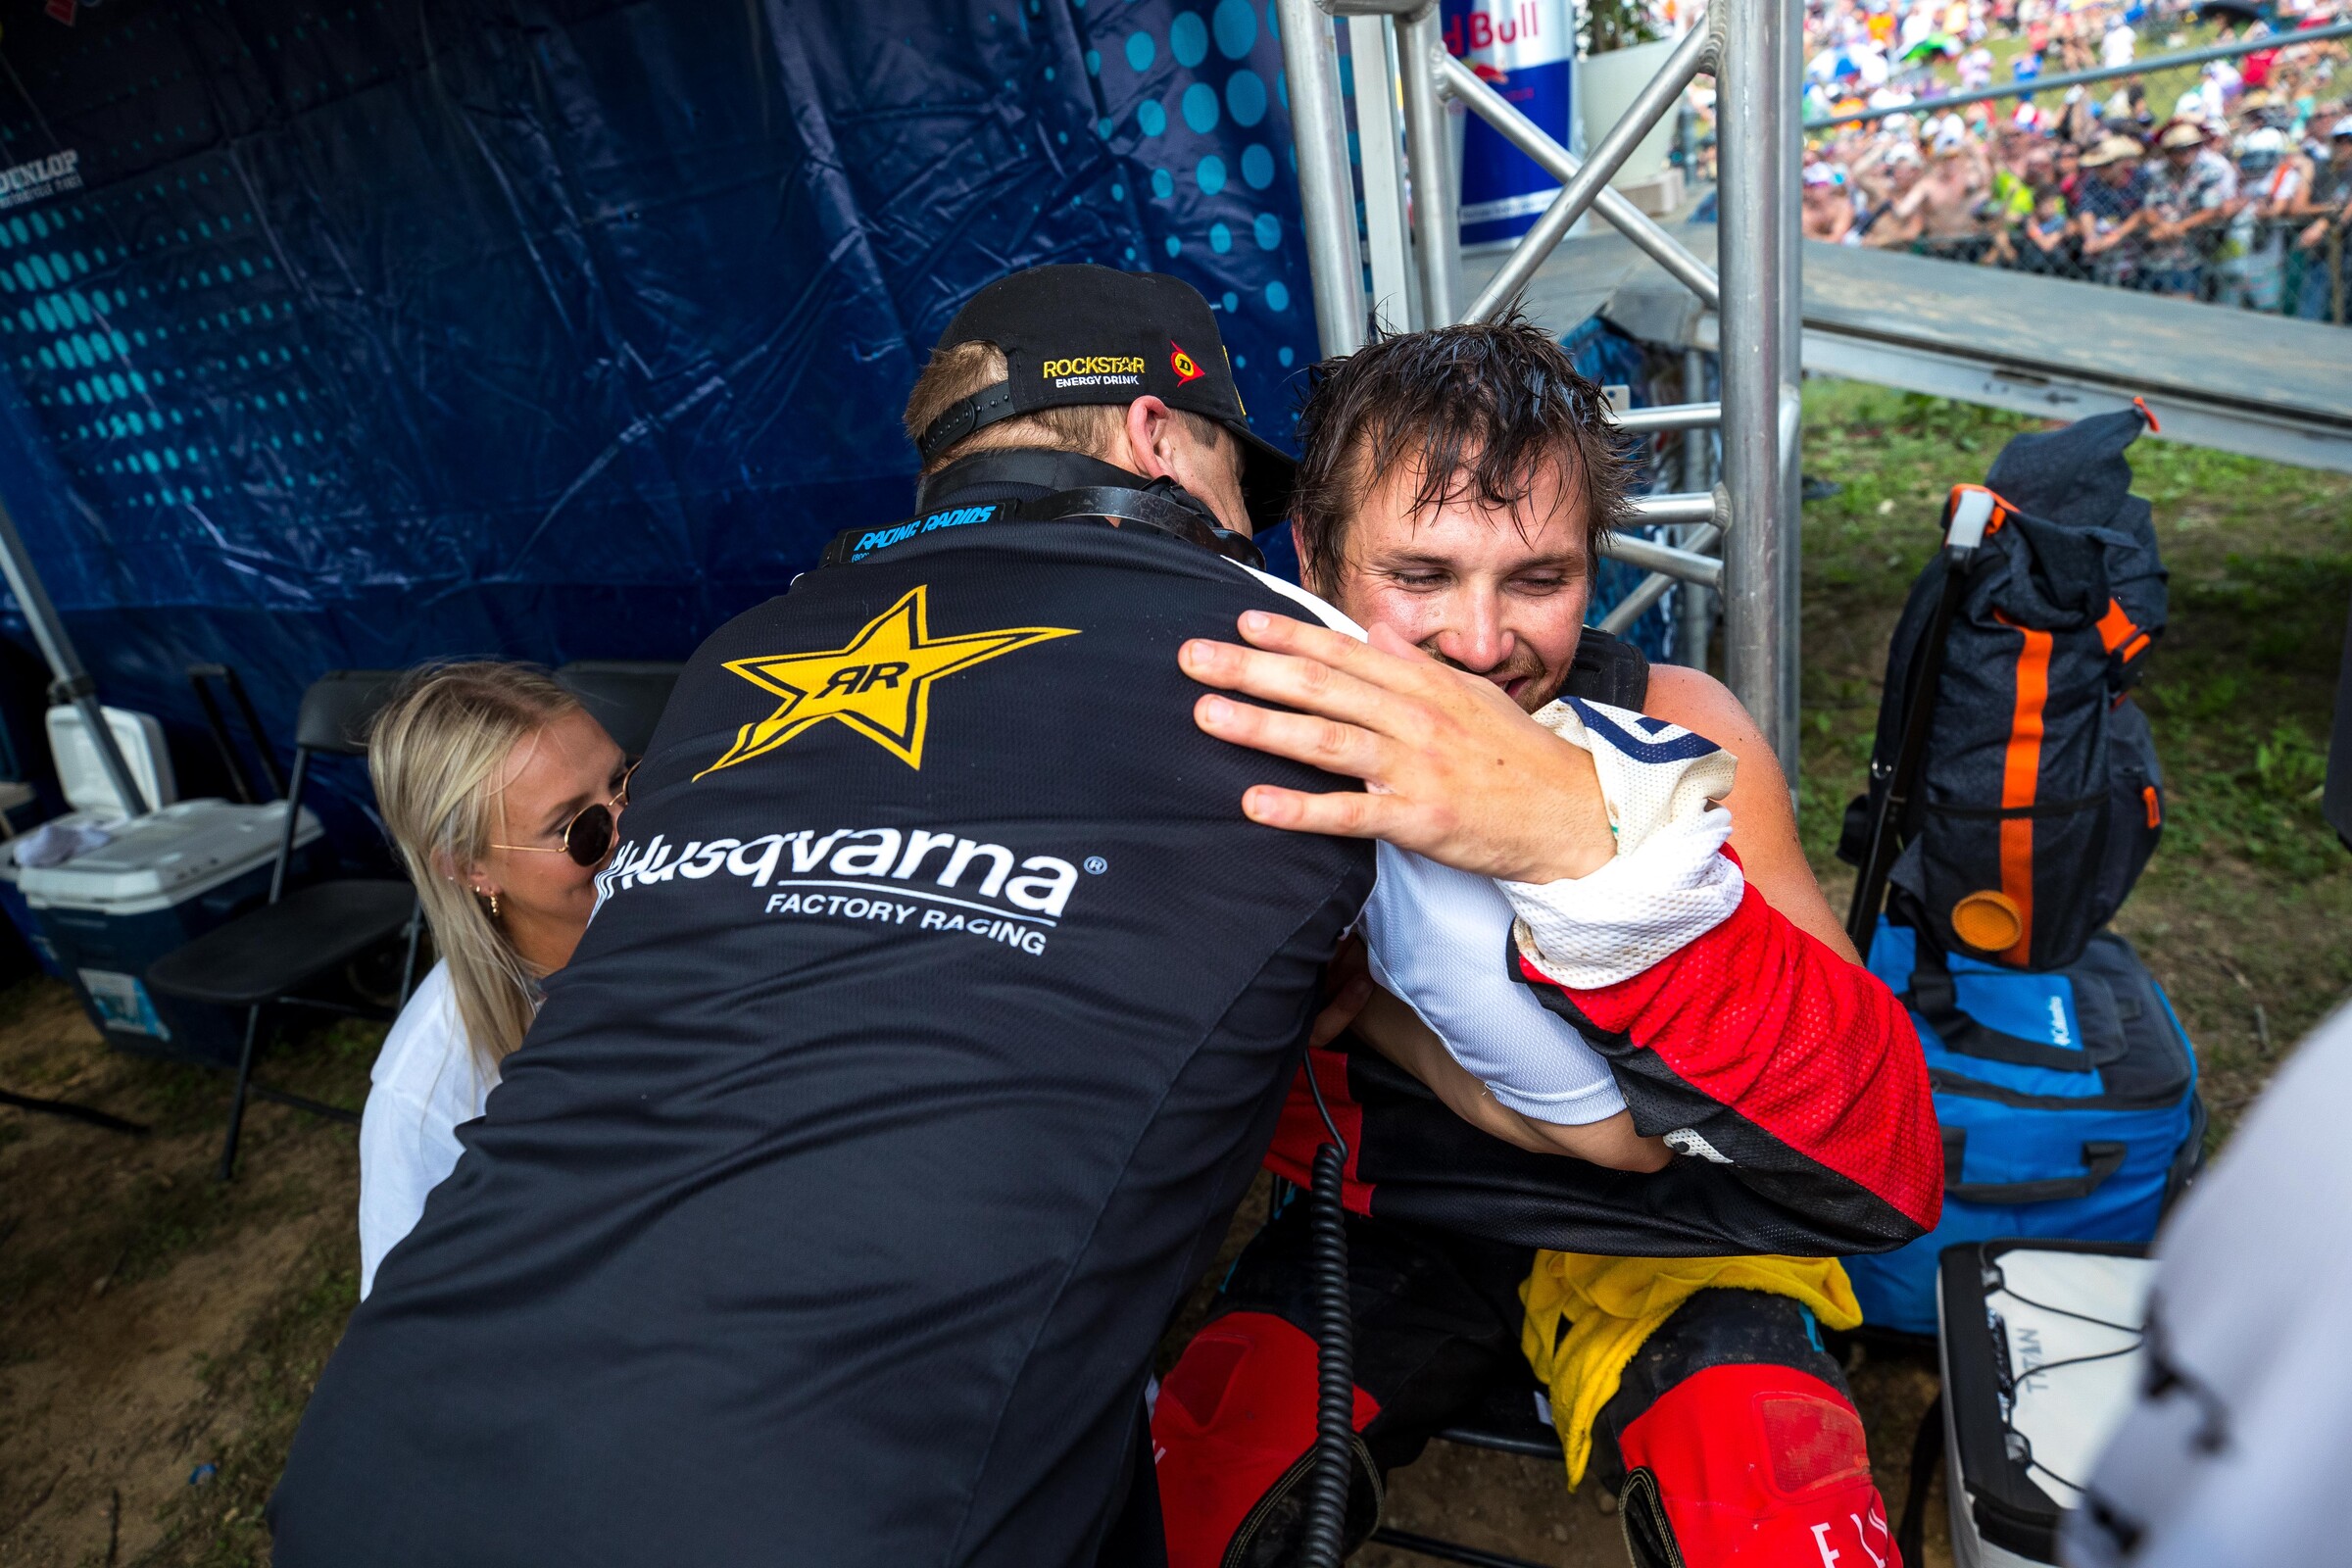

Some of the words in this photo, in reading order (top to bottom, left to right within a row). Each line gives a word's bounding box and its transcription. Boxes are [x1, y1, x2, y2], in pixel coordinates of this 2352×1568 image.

[1468, 2, 1538, 50] Bull
[1043, 357, 1145, 378] ROCKSTAR
[1055, 375, 1102, 388] ENERGY
[1103, 375, 1139, 385] DRINK
[854, 520, 921, 551] RACING
[921, 506, 997, 533] RADIOS
[621, 827, 1079, 917] Husqvarna
[764, 892, 918, 926] FACTORY
[919, 907, 1048, 956] RACING
